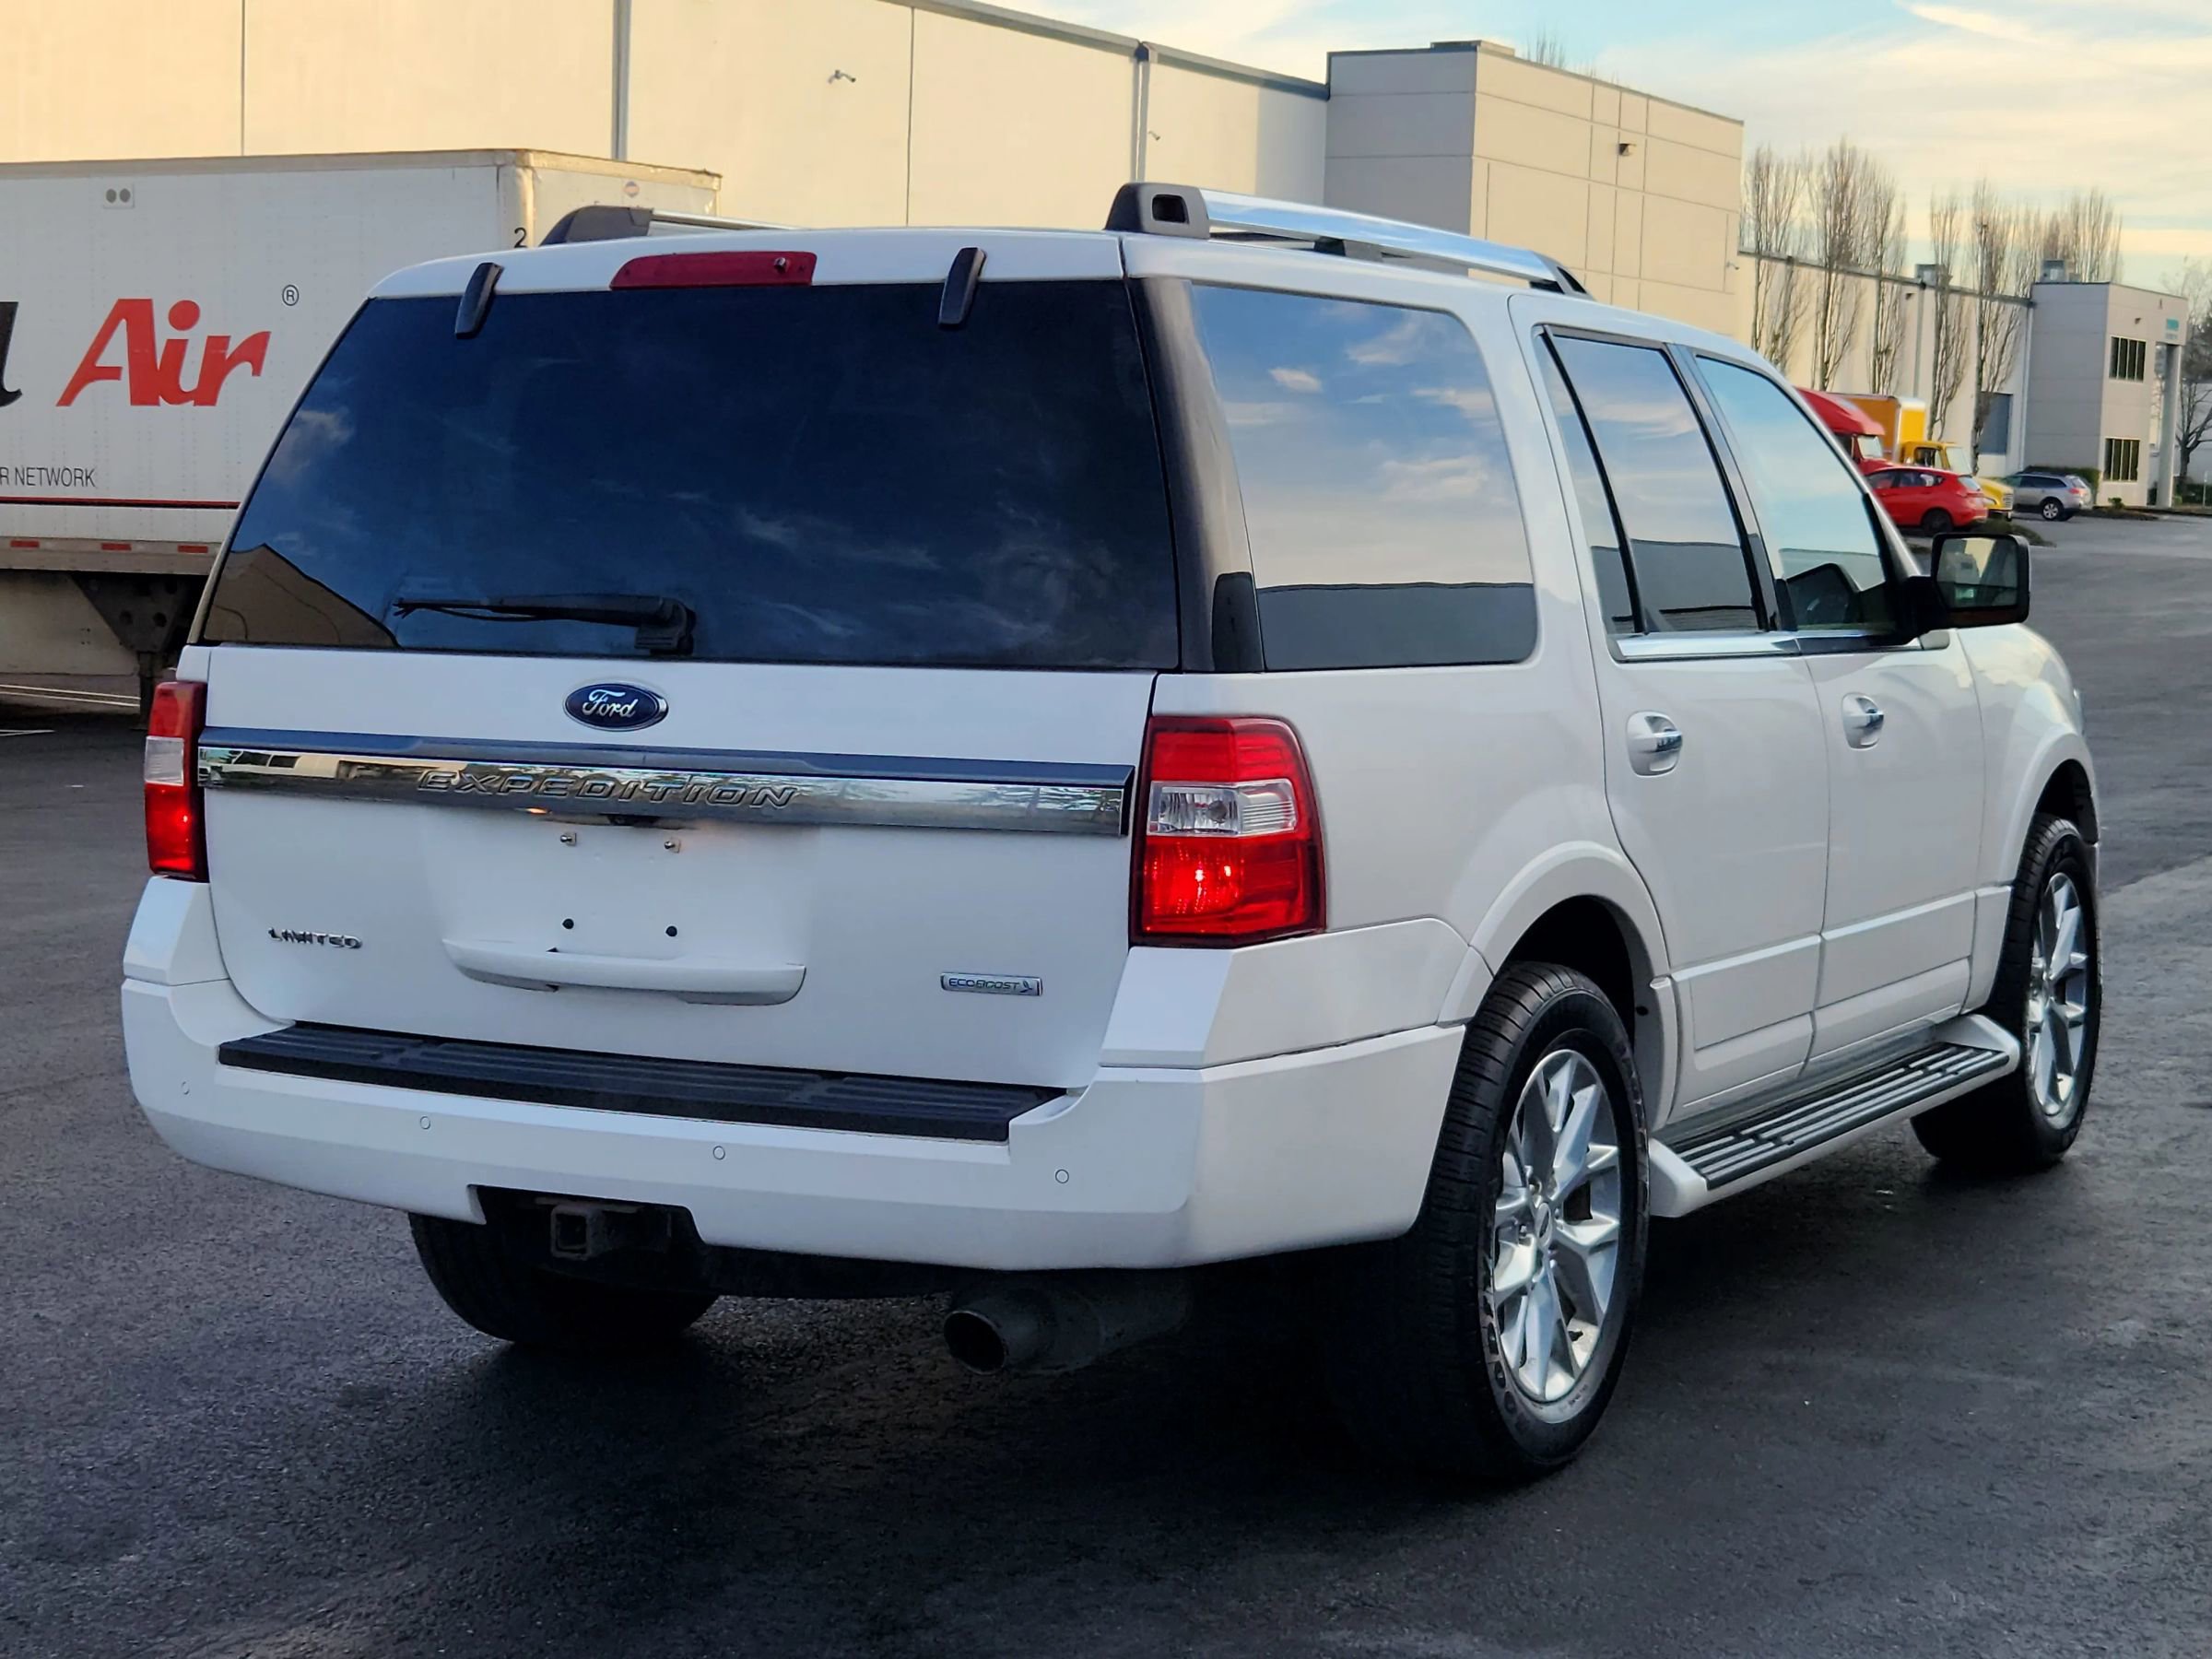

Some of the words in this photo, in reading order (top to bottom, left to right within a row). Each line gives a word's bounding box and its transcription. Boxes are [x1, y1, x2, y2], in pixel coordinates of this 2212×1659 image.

[513, 227, 528, 249] 2
[55, 298, 272, 407] Air
[15, 466, 97, 488] NETWORK
[582, 688, 640, 719] Ford
[417, 769, 800, 809] EXPEDITION
[267, 927, 363, 950] LIMITED
[948, 977, 1020, 991] ECOBOOST
